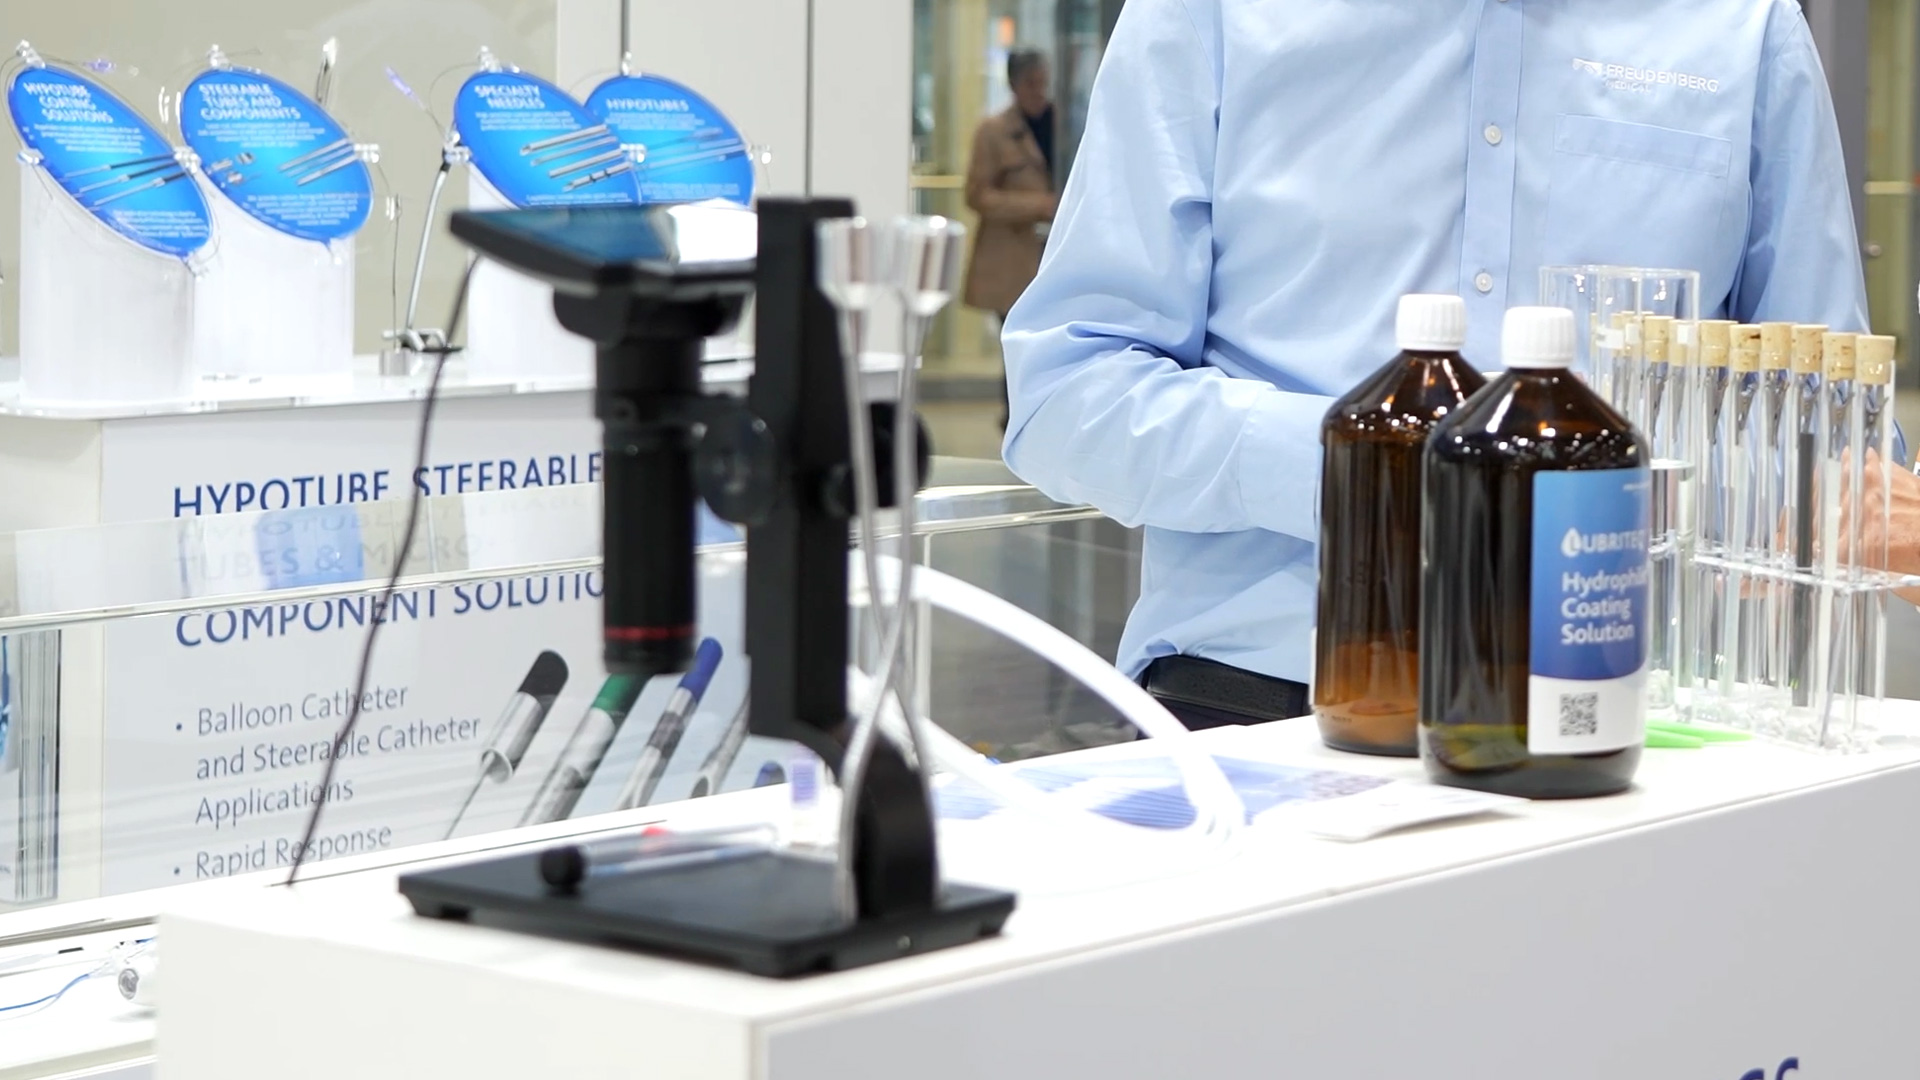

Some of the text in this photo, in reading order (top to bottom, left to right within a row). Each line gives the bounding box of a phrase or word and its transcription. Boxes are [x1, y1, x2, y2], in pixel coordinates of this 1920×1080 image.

[1606, 63, 1719, 93] FREUDENBERG
[23, 82, 91, 98] HYPOTUBE
[199, 83, 274, 97] STEERABLE
[474, 85, 540, 97] SPECIALTY
[1605, 79, 1652, 94] MEDICAL
[39, 96, 96, 110] COATING
[203, 95, 282, 110] TUBES AND
[487, 98, 545, 109] NEEDLES
[606, 98, 689, 112] HYPOTUBES
[42, 108, 113, 123] SOLUTIONS
[201, 107, 301, 120] COMPONENTS
[174, 470, 389, 517] HYPOTUBE
[413, 452, 602, 496] STEERABLE
[176, 572, 603, 647] COMPONENT SOLUTIO
[1561, 597, 1631, 621] Coating
[1561, 621, 1635, 645] Solution
[197, 684, 408, 736] Balloon Catheter
[196, 716, 481, 780] and Steerable Catheter
[195, 780, 354, 829] Applications
[196, 826, 392, 878] Rapid Response
